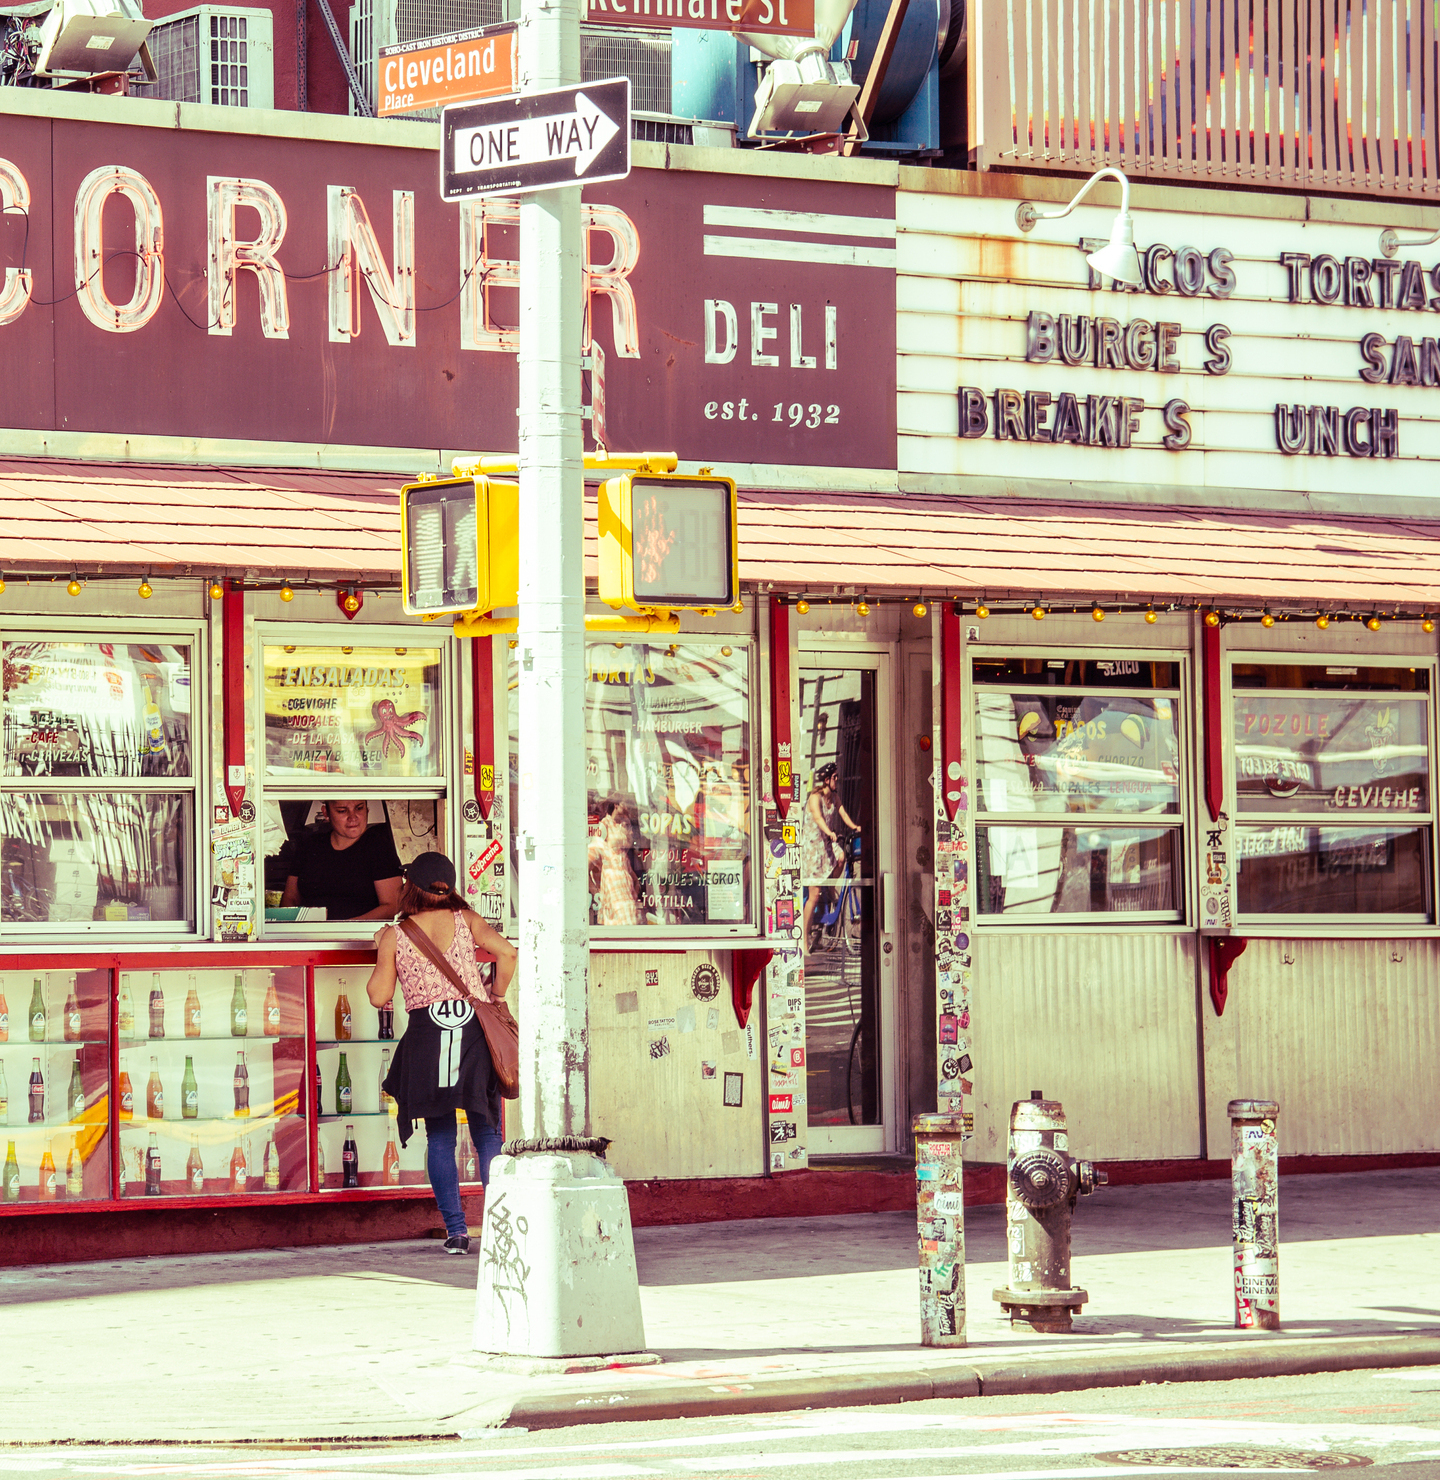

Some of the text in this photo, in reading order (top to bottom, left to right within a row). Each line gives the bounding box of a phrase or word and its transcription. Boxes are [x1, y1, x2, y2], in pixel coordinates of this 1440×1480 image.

[417, 40, 431, 50] IRON
[432, 34, 457, 48] HISTORIC
[458, 28, 485, 42] DISTRICT
[384, 39, 496, 92] Cleveland
[384, 92, 414, 111] Place
[470, 115, 600, 166] ONE WAY
[704, 299, 837, 370] DELI
[704, 398, 841, 429] est. 1932
[1276, 402, 1400, 459] UNCH
[285, 666, 406, 687] ENSALADAS
[586, 663, 656, 684] TORTAS
[292, 715, 341, 729] NOPALES
[637, 720, 703, 734] HAMBURGER
[1054, 719, 1107, 740] TACOS
[1244, 714, 1329, 737] POZOLE
[31, 731, 59, 743] CAFE
[292, 733, 356, 745] DE LA CASA
[30, 749, 89, 762] CERVEZAS
[292, 750, 322, 762] MAIZ
[325, 750, 333, 762] Y
[1098, 755, 1145, 768] CHORIZO
[1052, 781, 1152, 794] NOPALES LENGUA
[1335, 785, 1420, 809] CEVICHE
[640, 813, 692, 834] SOPAS
[471, 843, 500, 876] Supreme
[642, 848, 688, 863] POZOLE
[642, 872, 740, 886] FRIJOLES NEGROS
[642, 893, 694, 908] TORTILLA
[438, 1000, 466, 1019] 40
[788, 998, 801, 1006] DIPS
